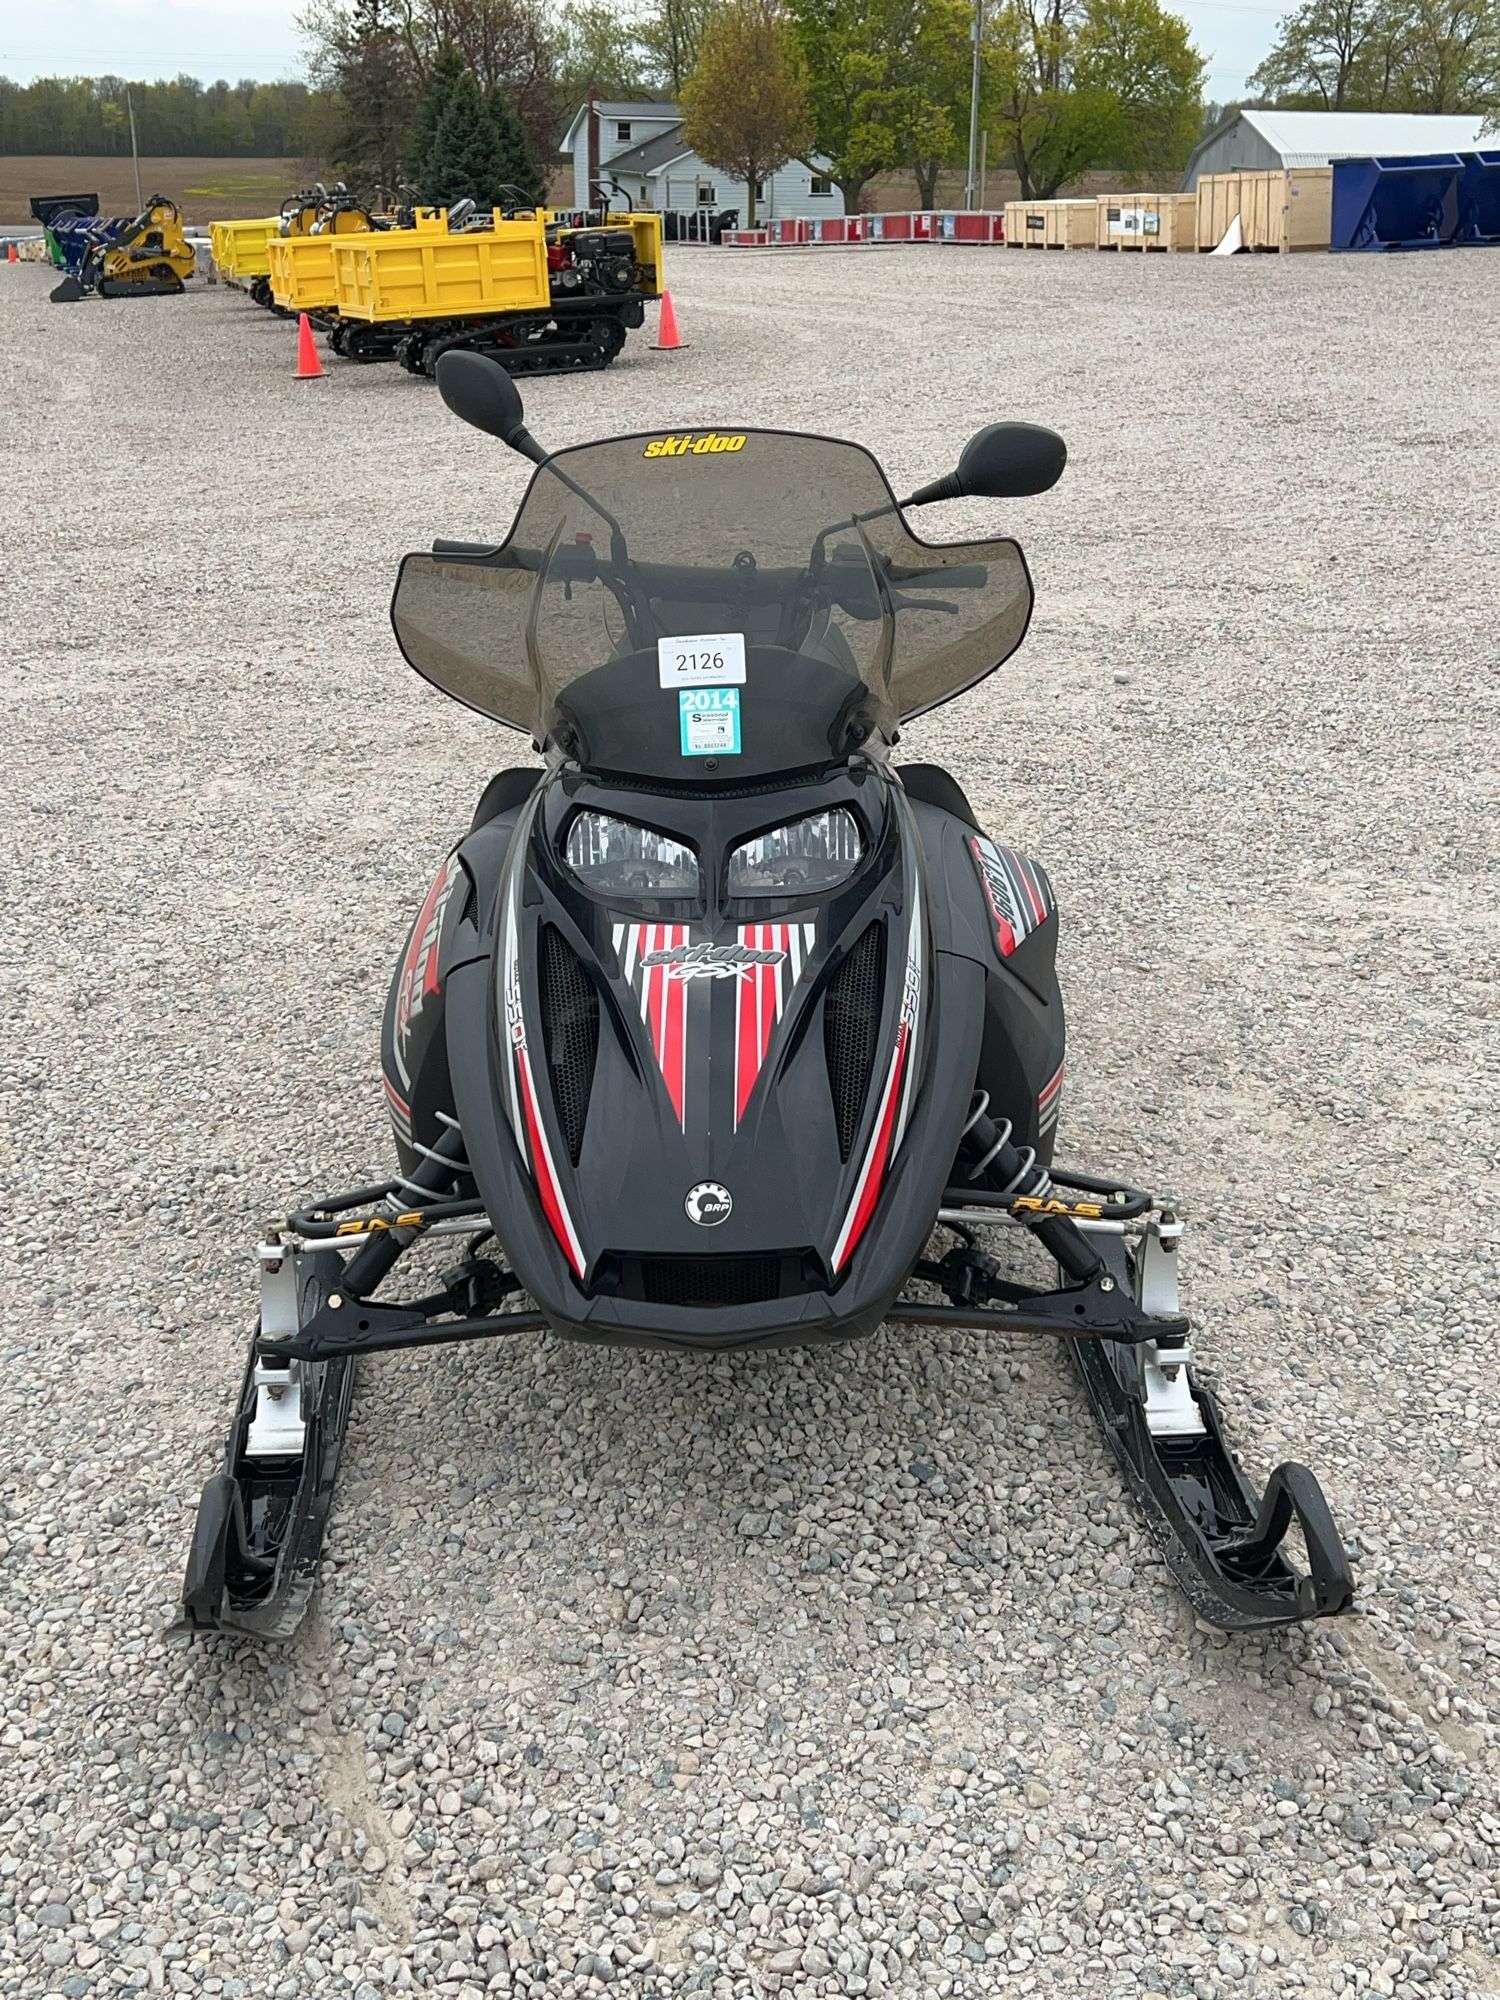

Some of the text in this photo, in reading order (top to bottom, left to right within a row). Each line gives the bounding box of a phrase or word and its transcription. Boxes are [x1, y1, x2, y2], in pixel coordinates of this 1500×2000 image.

[643, 432, 747, 458] ski-doo
[675, 651, 724, 671] 2126
[680, 688, 738, 710] 2014
[640, 942, 788, 967] ski-doo
[666, 961, 755, 984] GSX
[703, 1203, 730, 1213] BRP
[1011, 1196, 1105, 1220] RAS
[335, 1211, 425, 1238] RAS
